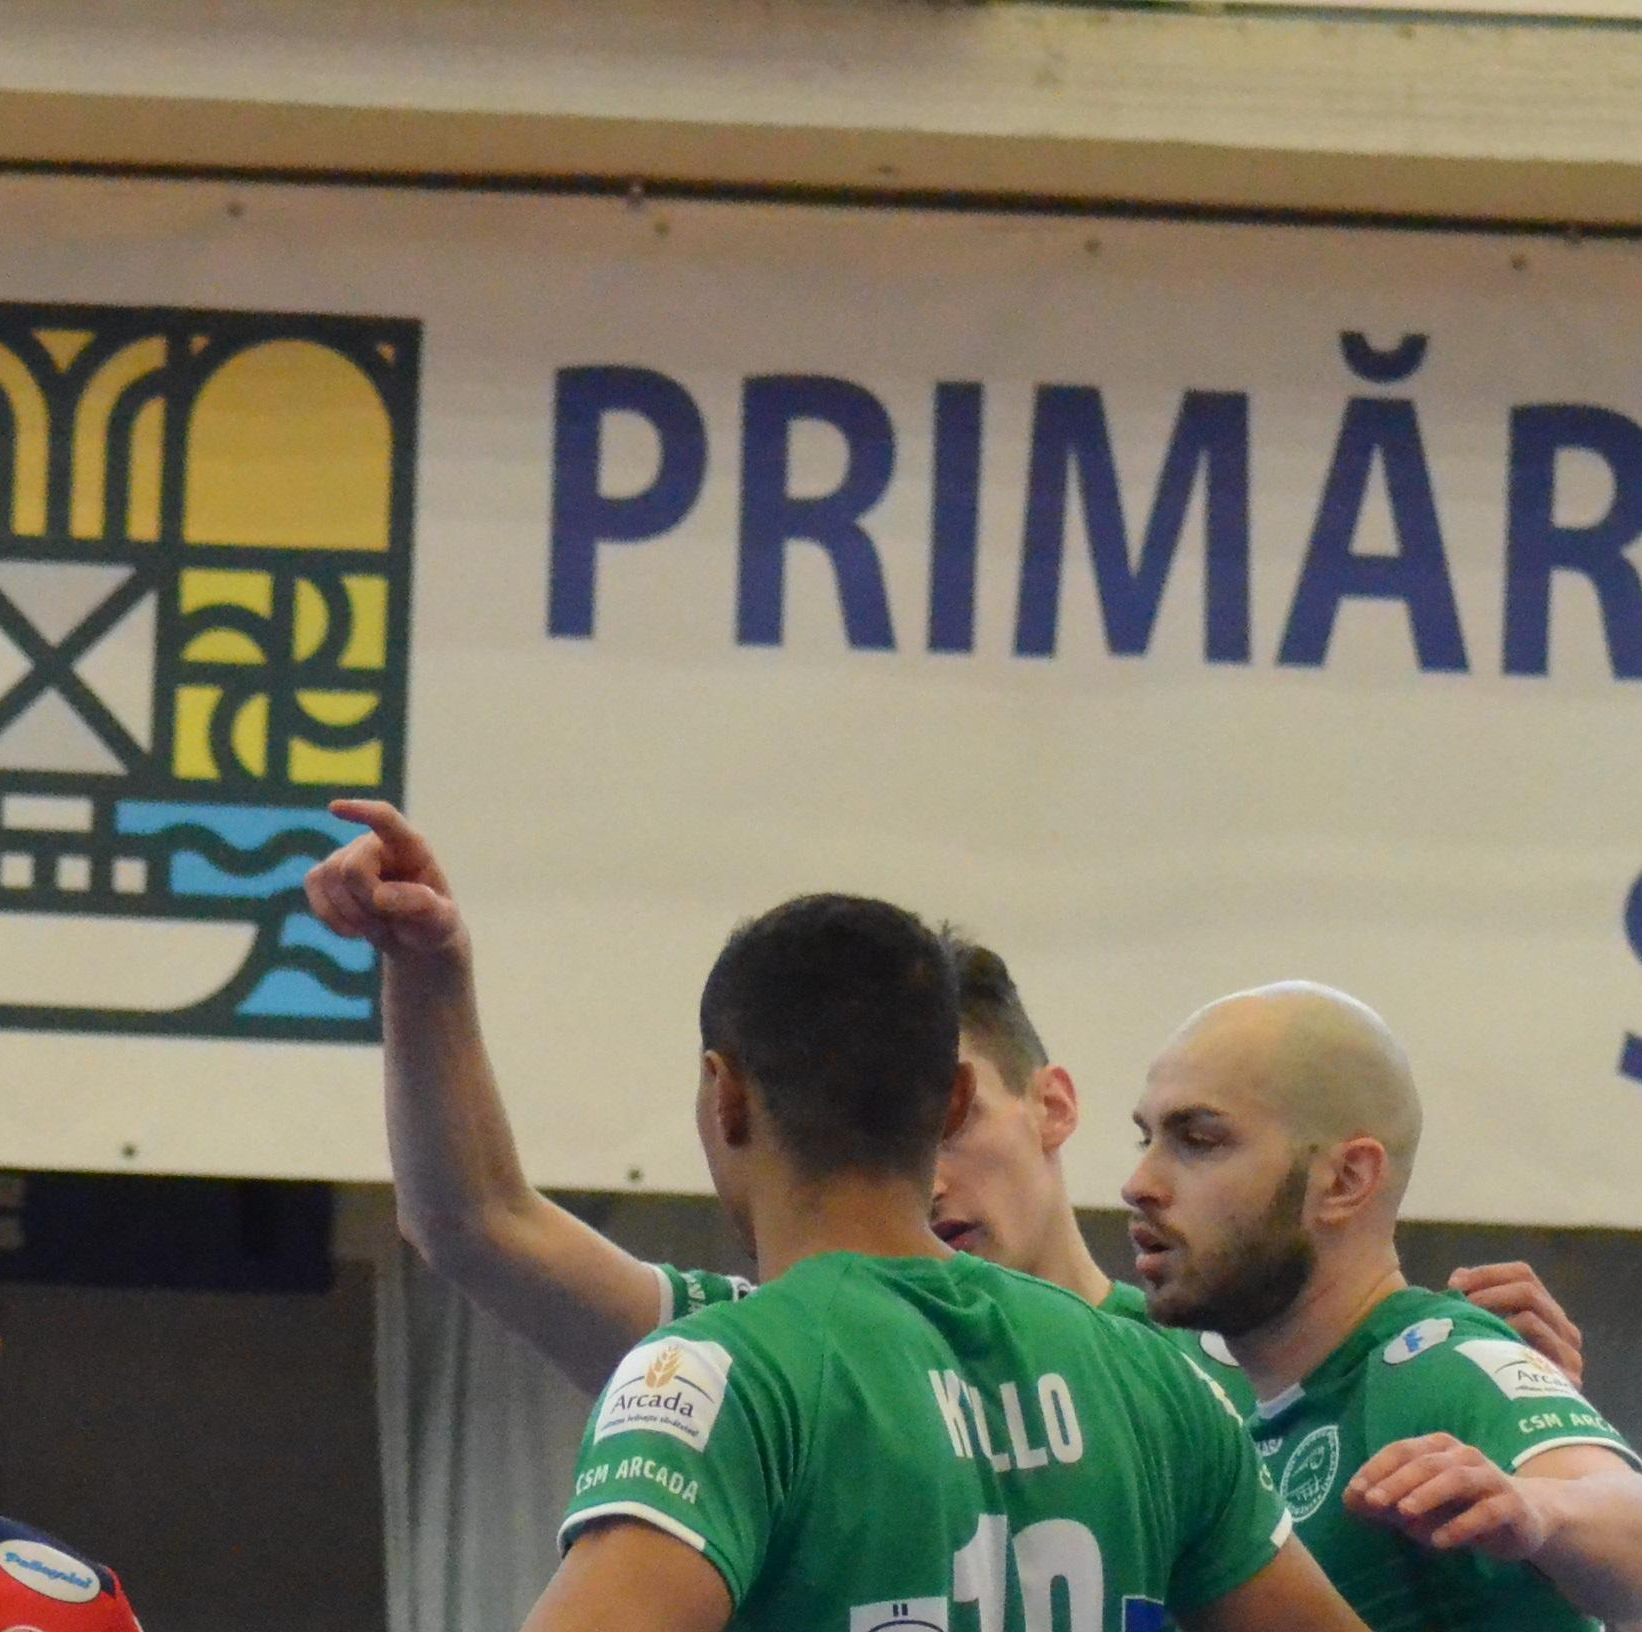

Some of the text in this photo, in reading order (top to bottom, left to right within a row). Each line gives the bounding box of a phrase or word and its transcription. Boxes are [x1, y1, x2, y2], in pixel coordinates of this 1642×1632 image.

[611, 1392, 694, 1419] Arcada
[1518, 1413, 1563, 1434] CSM
[575, 1456, 699, 1504] CSM ARCADA
